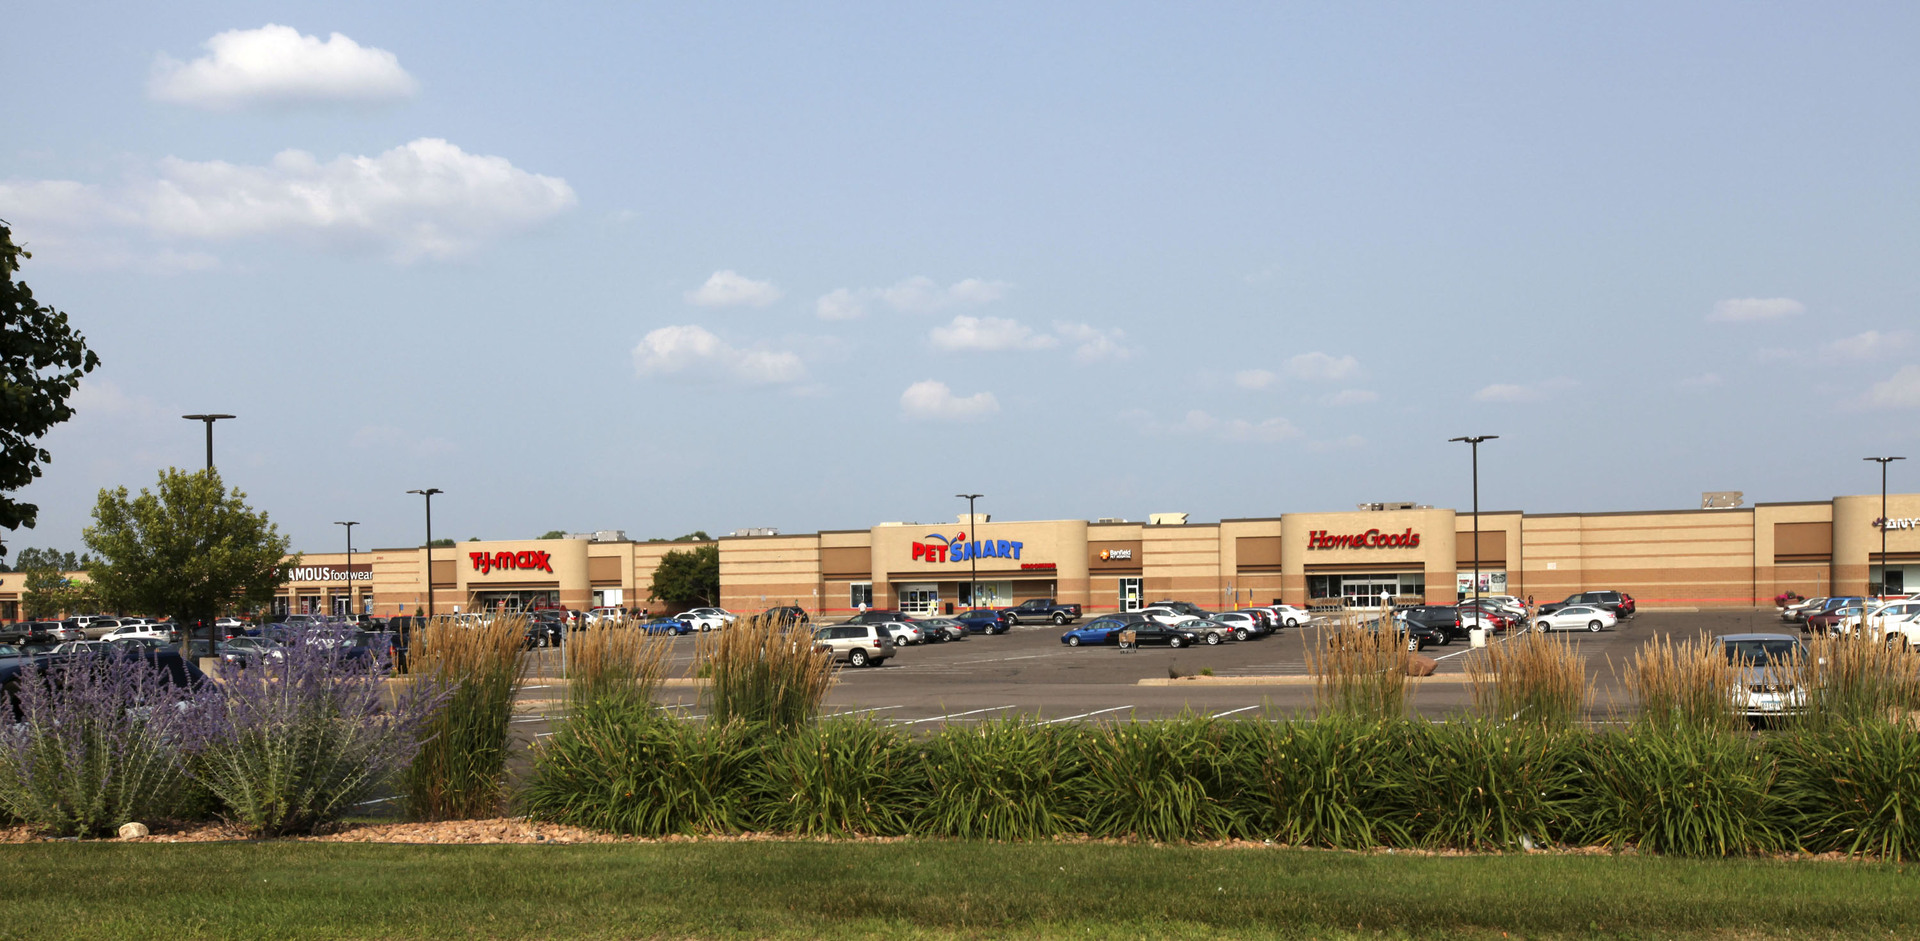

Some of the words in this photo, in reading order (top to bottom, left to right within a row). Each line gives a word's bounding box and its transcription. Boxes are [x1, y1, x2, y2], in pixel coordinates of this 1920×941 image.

[1886, 518, 1920, 529] ANY
[1307, 527, 1420, 549] HomeGoods
[912, 540, 1023, 562] PETSMART
[288, 567, 331, 581] AMOUS
[331, 569, 373, 580] footwear
